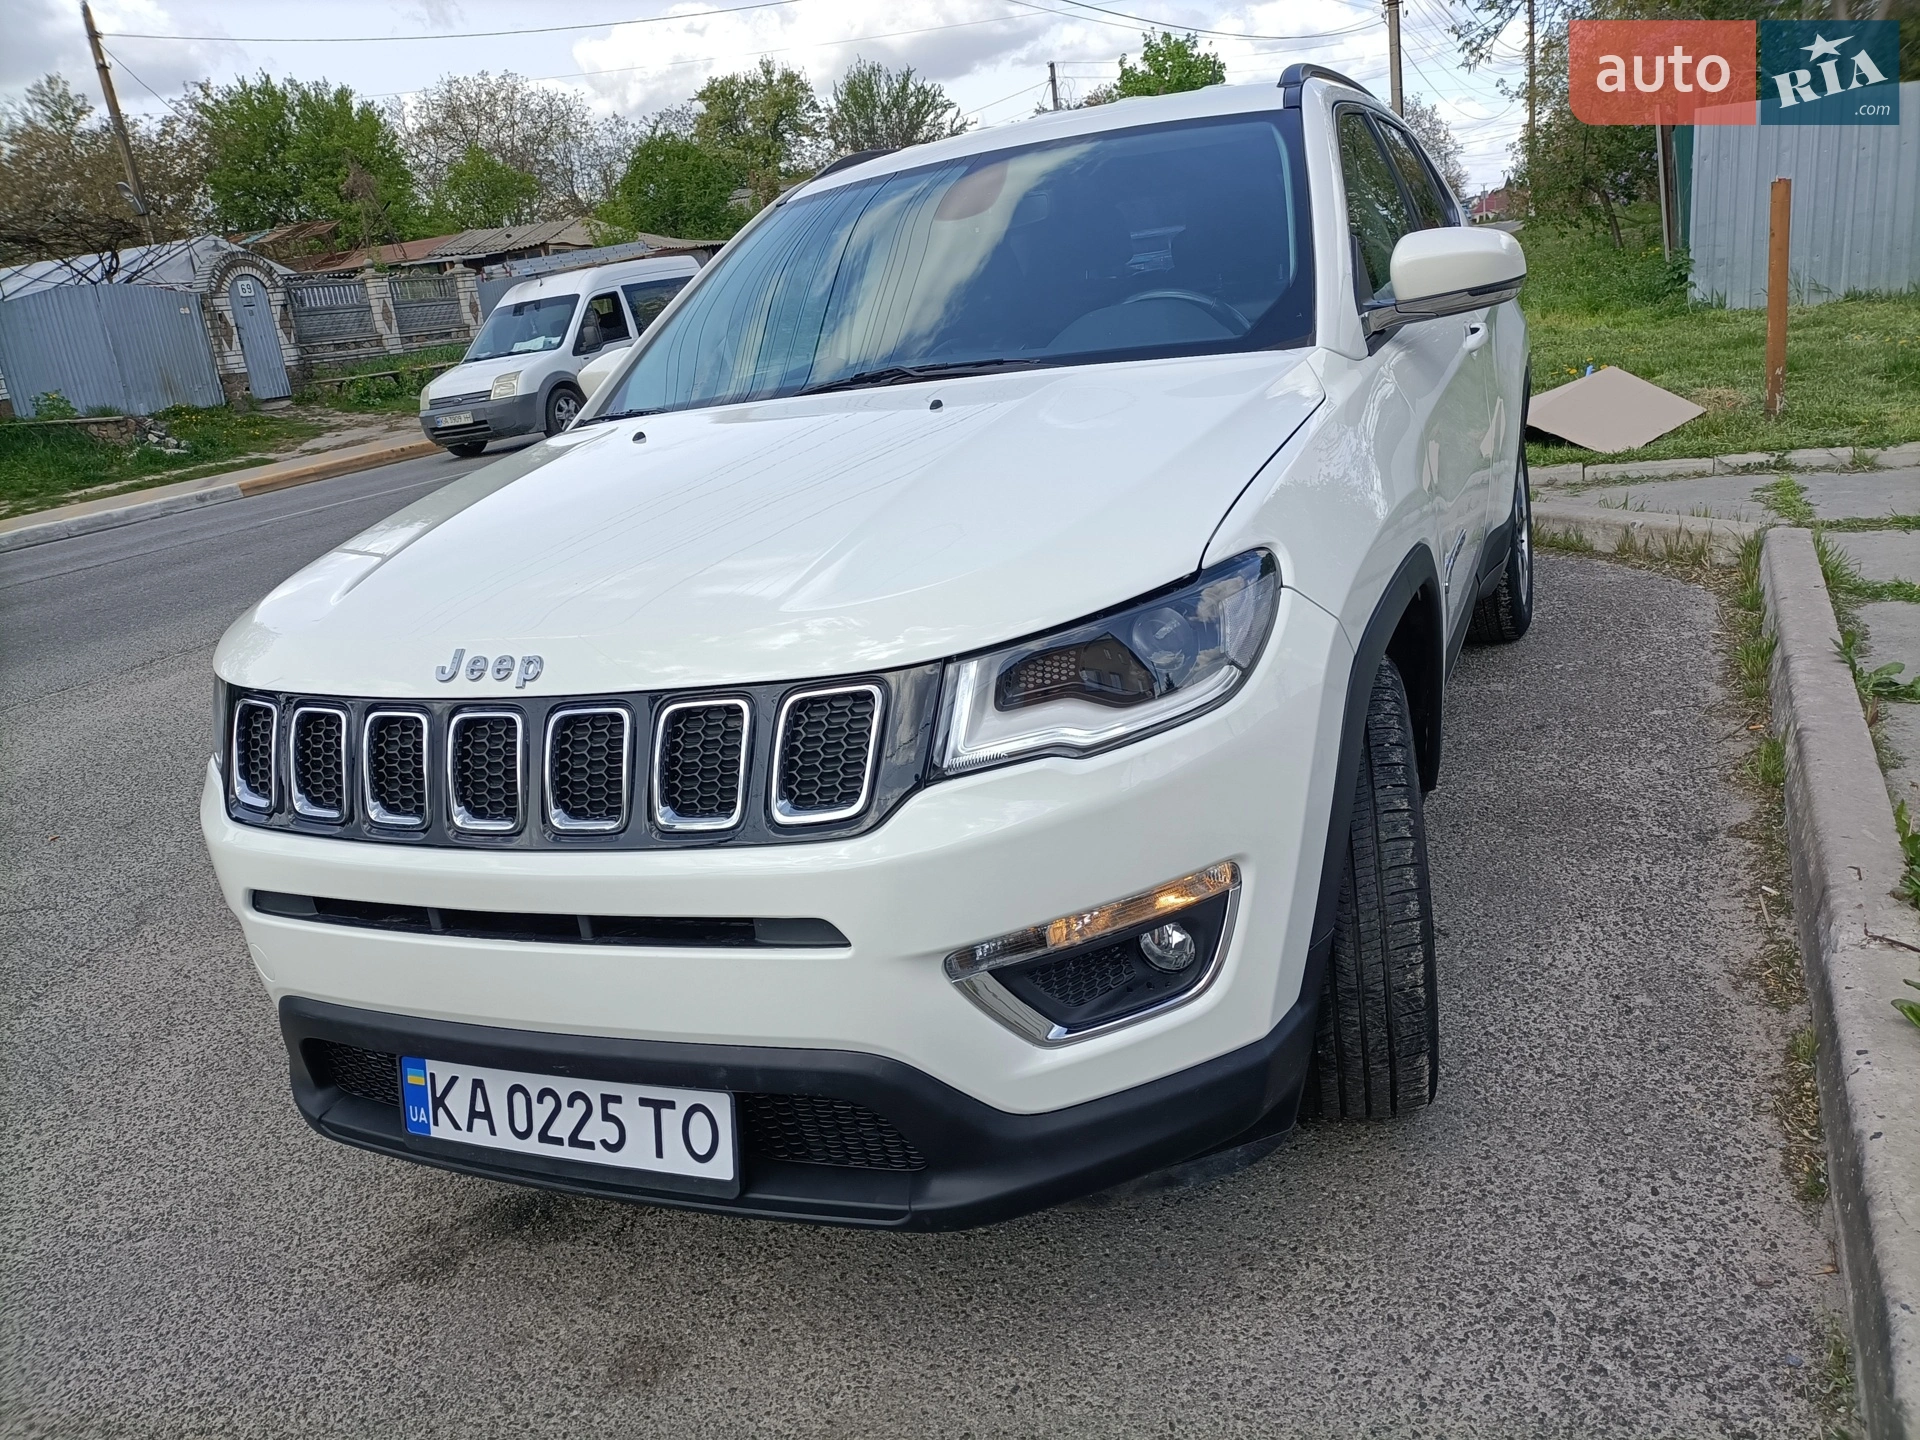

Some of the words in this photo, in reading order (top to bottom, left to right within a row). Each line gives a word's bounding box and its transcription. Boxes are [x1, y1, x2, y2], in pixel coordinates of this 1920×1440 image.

[240, 283, 252, 294] 69
[435, 648, 545, 690] Jeep
[409, 1105, 429, 1125] UA
[429, 1072, 498, 1137] KA
[506, 1083, 627, 1153] 0225
[638, 1096, 720, 1165] TO
